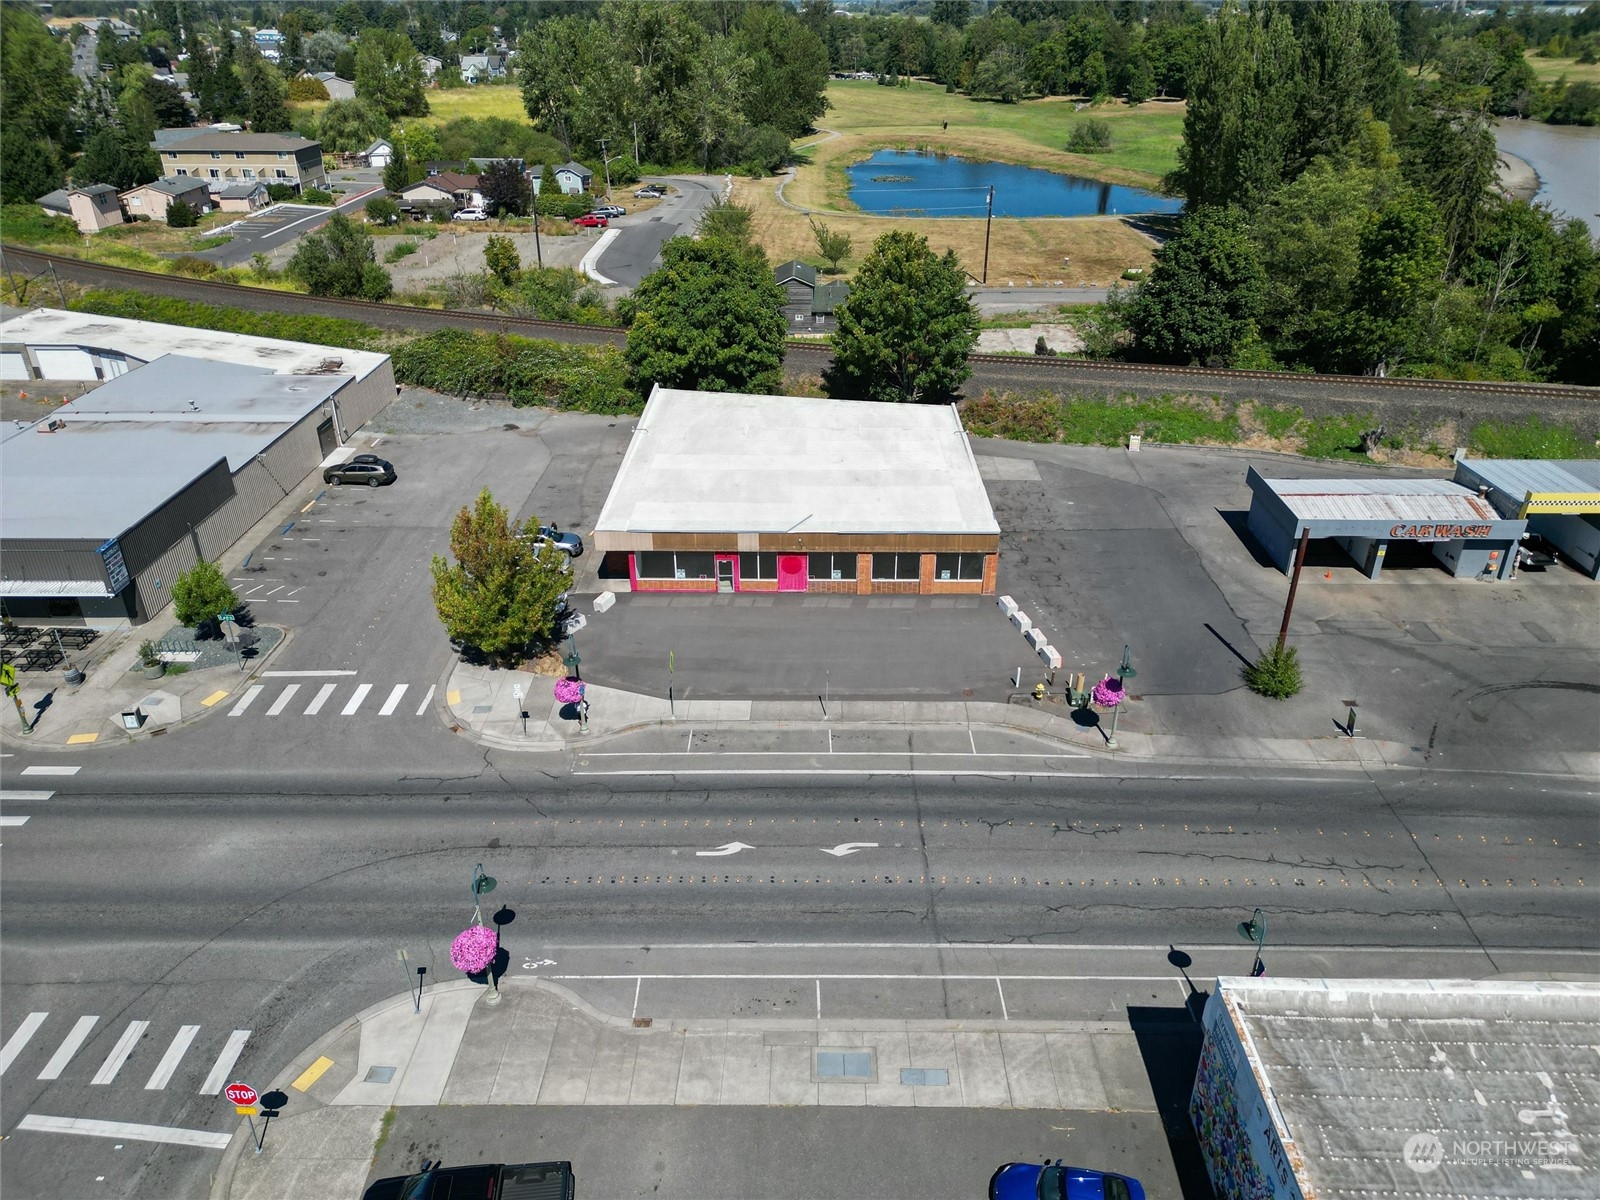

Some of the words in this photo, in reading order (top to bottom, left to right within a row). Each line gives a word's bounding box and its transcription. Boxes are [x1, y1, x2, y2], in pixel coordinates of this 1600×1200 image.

[1390, 524, 1433, 538] CAR
[1434, 524, 1492, 538] WASH
[228, 1090, 254, 1099] STOP
[1263, 1129, 1288, 1186] ARTS
